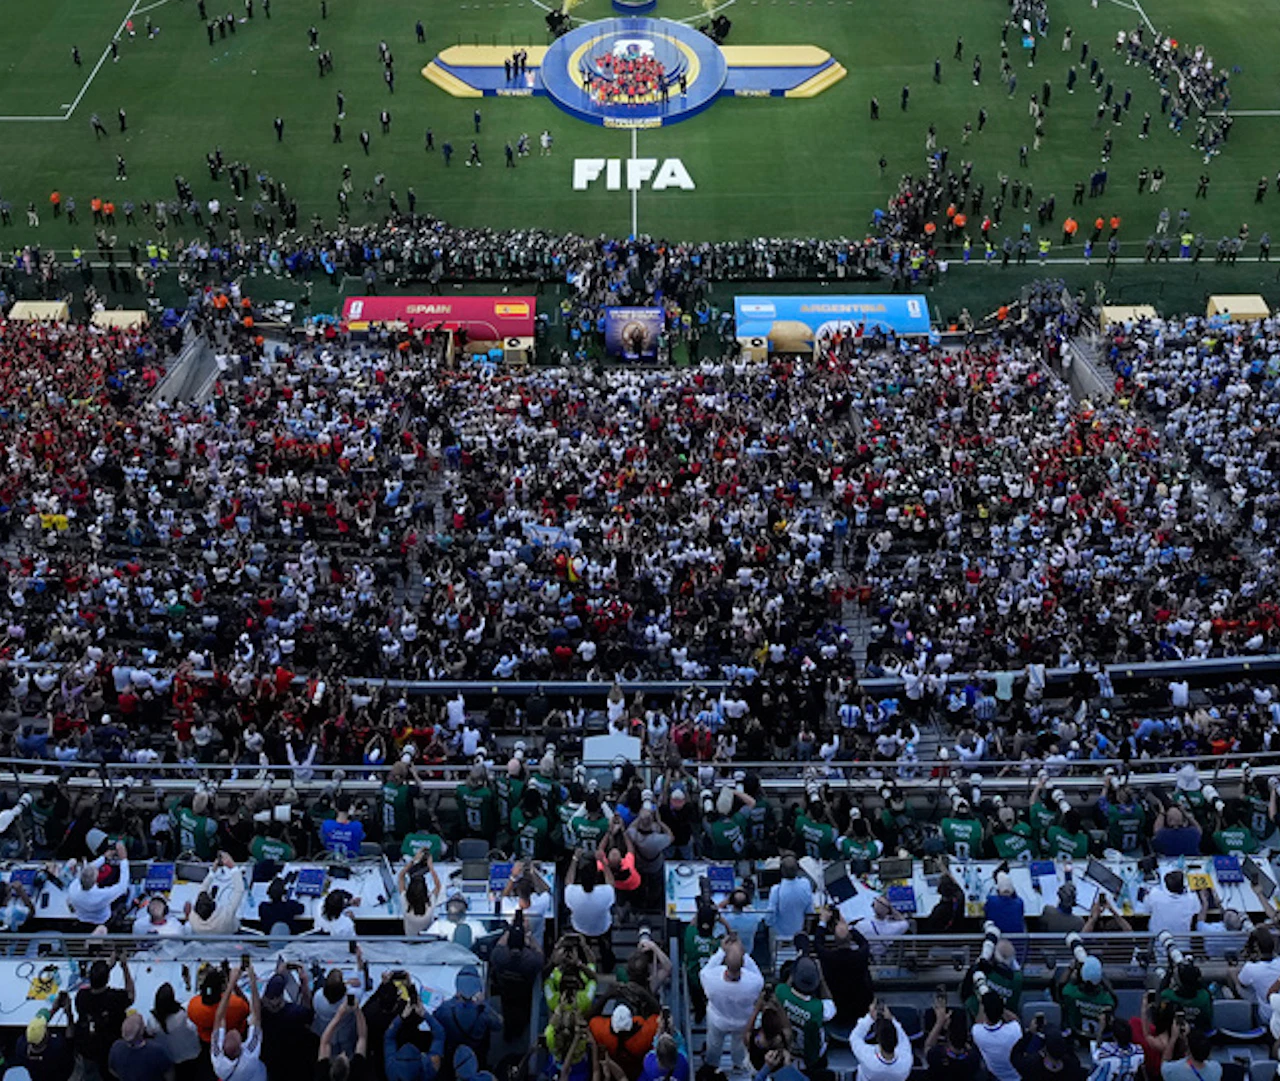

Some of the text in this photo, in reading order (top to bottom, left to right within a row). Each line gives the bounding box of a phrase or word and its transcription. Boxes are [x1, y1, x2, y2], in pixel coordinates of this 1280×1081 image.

[573, 158, 696, 190] FIFA
[406, 304, 452, 314] SPAIN
[800, 304, 887, 313] ARGENTINA
[783, 999, 811, 1020] PHOTO
